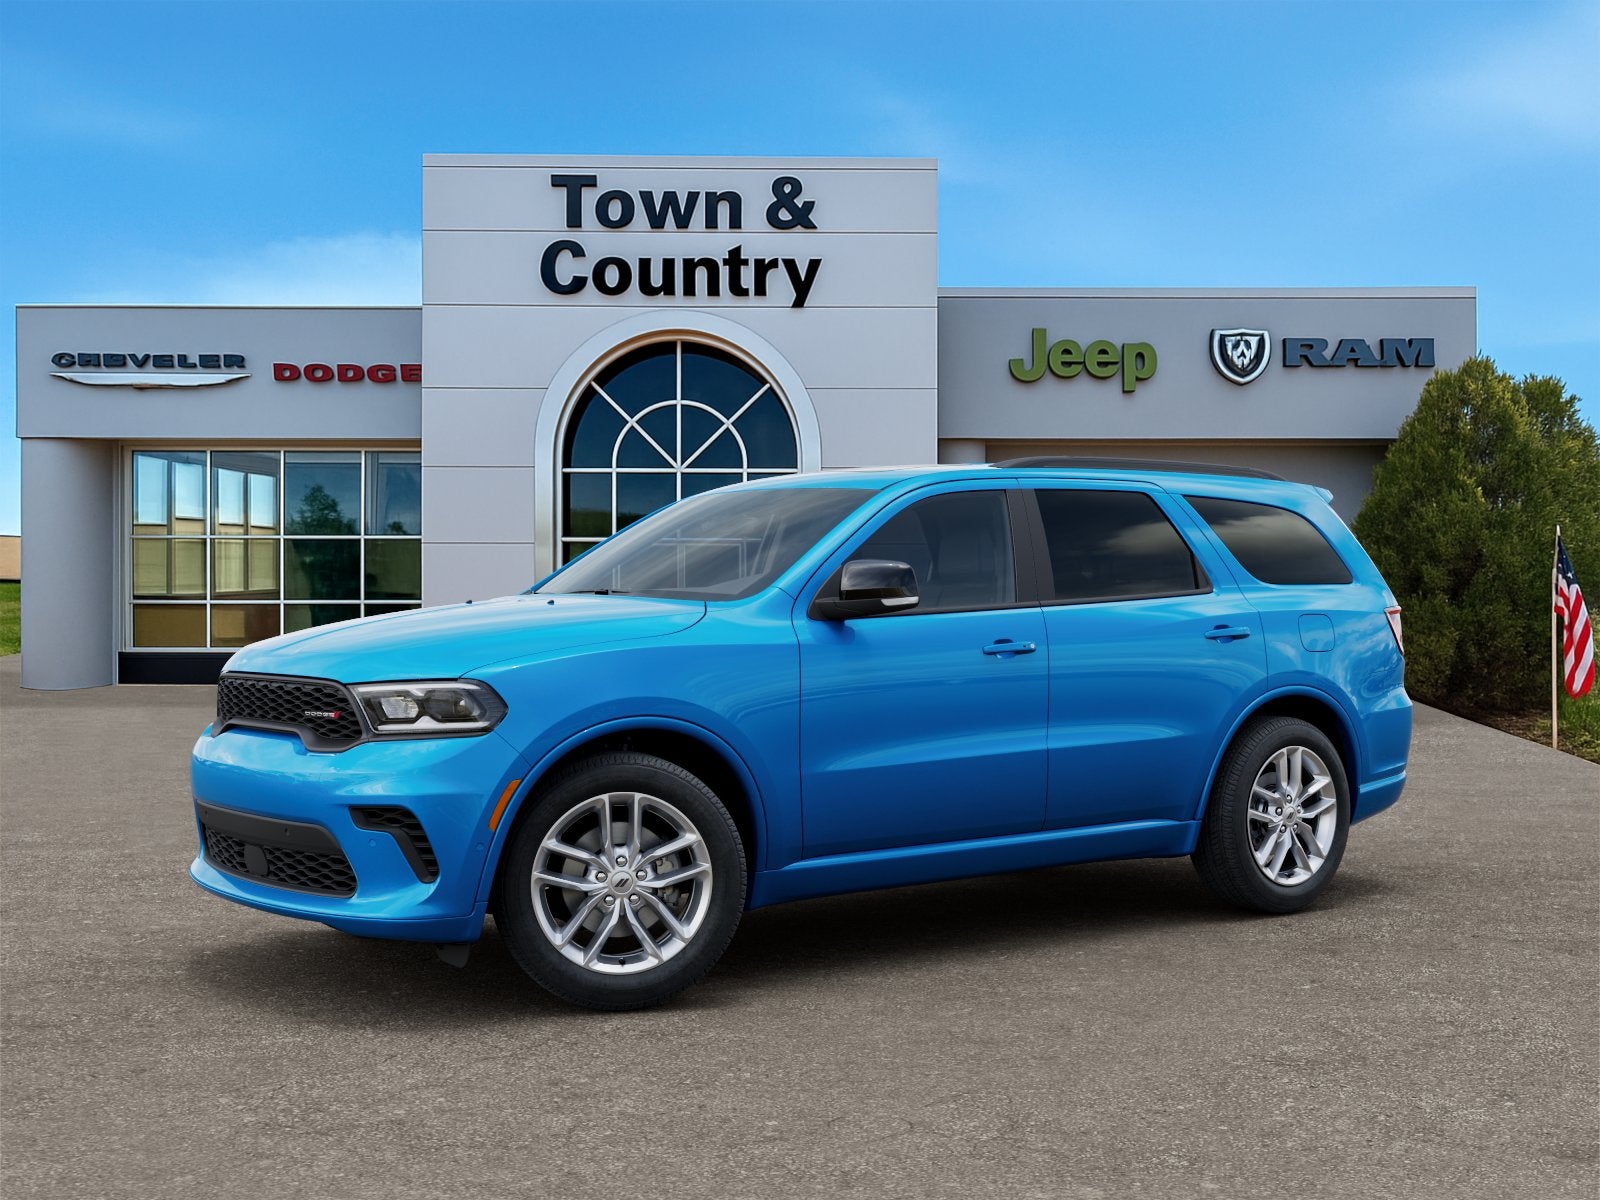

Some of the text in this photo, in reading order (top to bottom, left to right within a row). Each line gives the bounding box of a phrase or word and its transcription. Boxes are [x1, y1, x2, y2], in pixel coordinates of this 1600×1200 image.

[550, 174, 817, 229] Town &
[540, 240, 822, 308] Country
[273, 363, 422, 382] DODGE
[1009, 328, 1157, 392] Jeep
[1283, 338, 1435, 367] RAM
